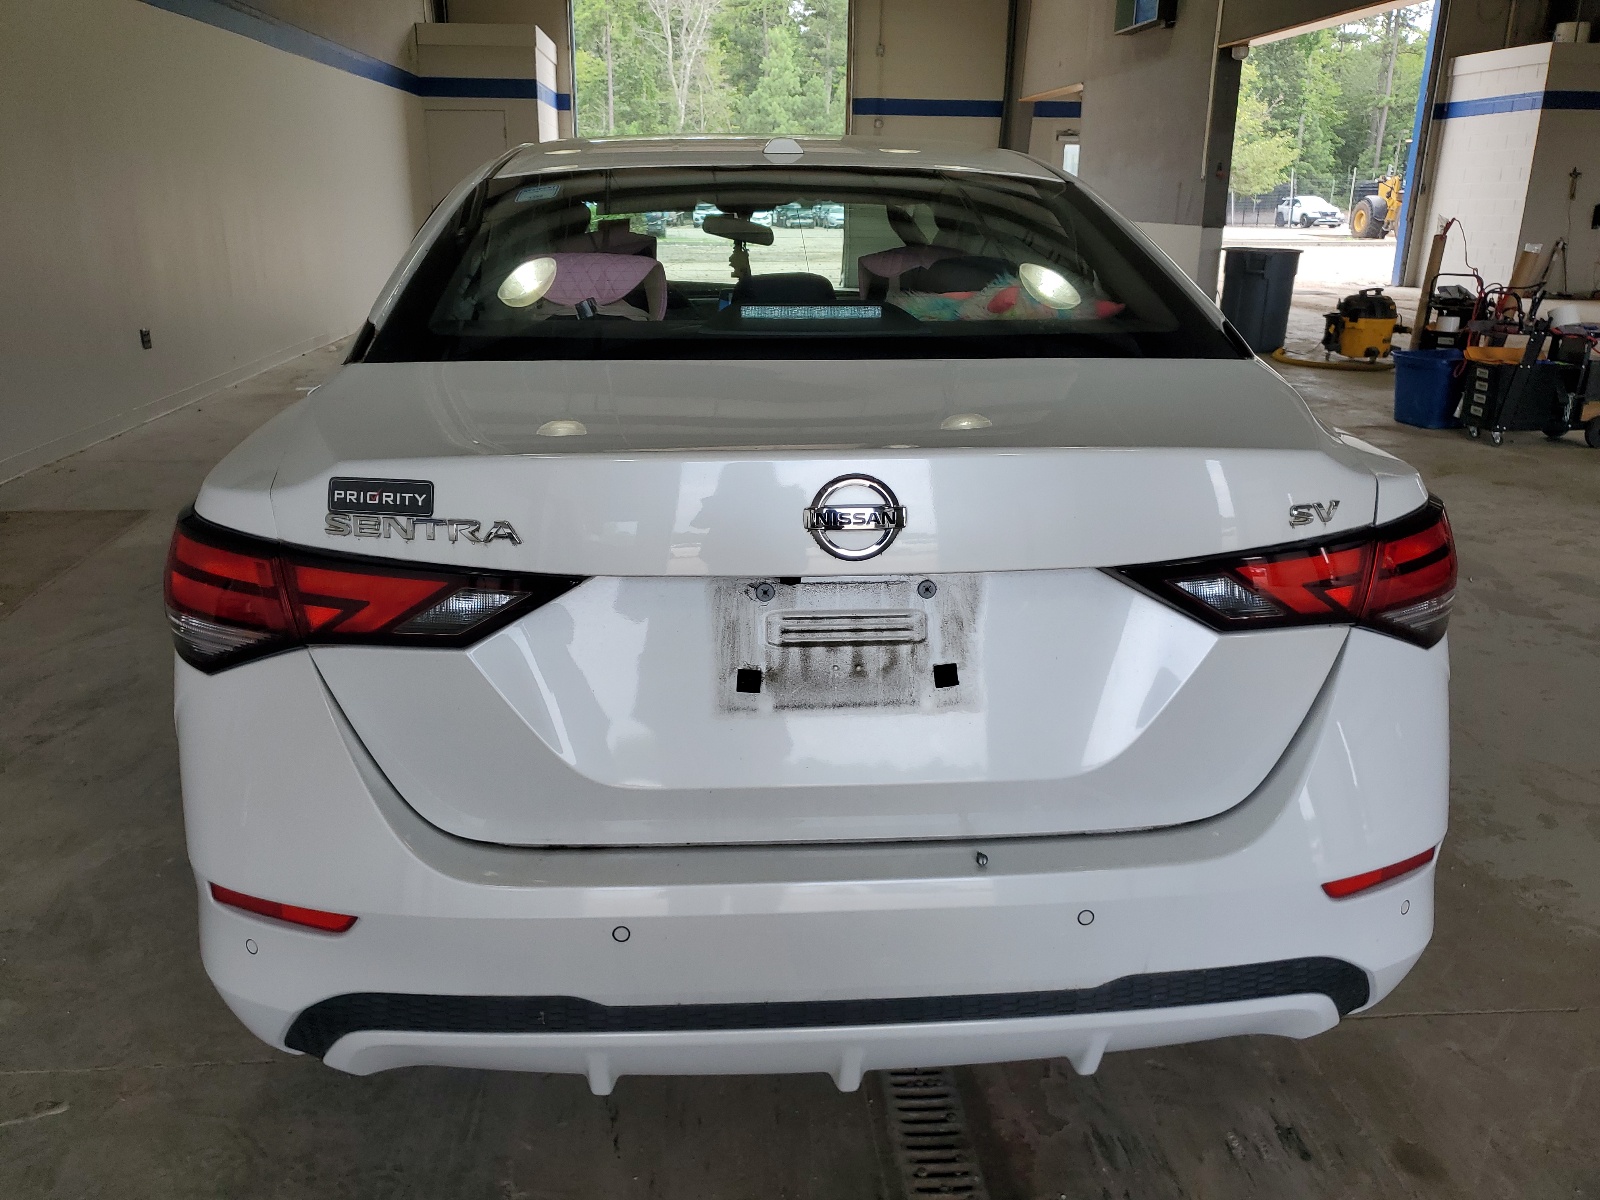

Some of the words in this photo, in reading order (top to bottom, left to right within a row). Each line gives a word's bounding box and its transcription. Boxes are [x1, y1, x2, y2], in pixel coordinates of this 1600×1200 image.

[334, 490, 427, 506] PRIORITY
[815, 511, 896, 526] NISSAN
[1289, 500, 1340, 526] SV
[324, 512, 522, 545] SENTRA
